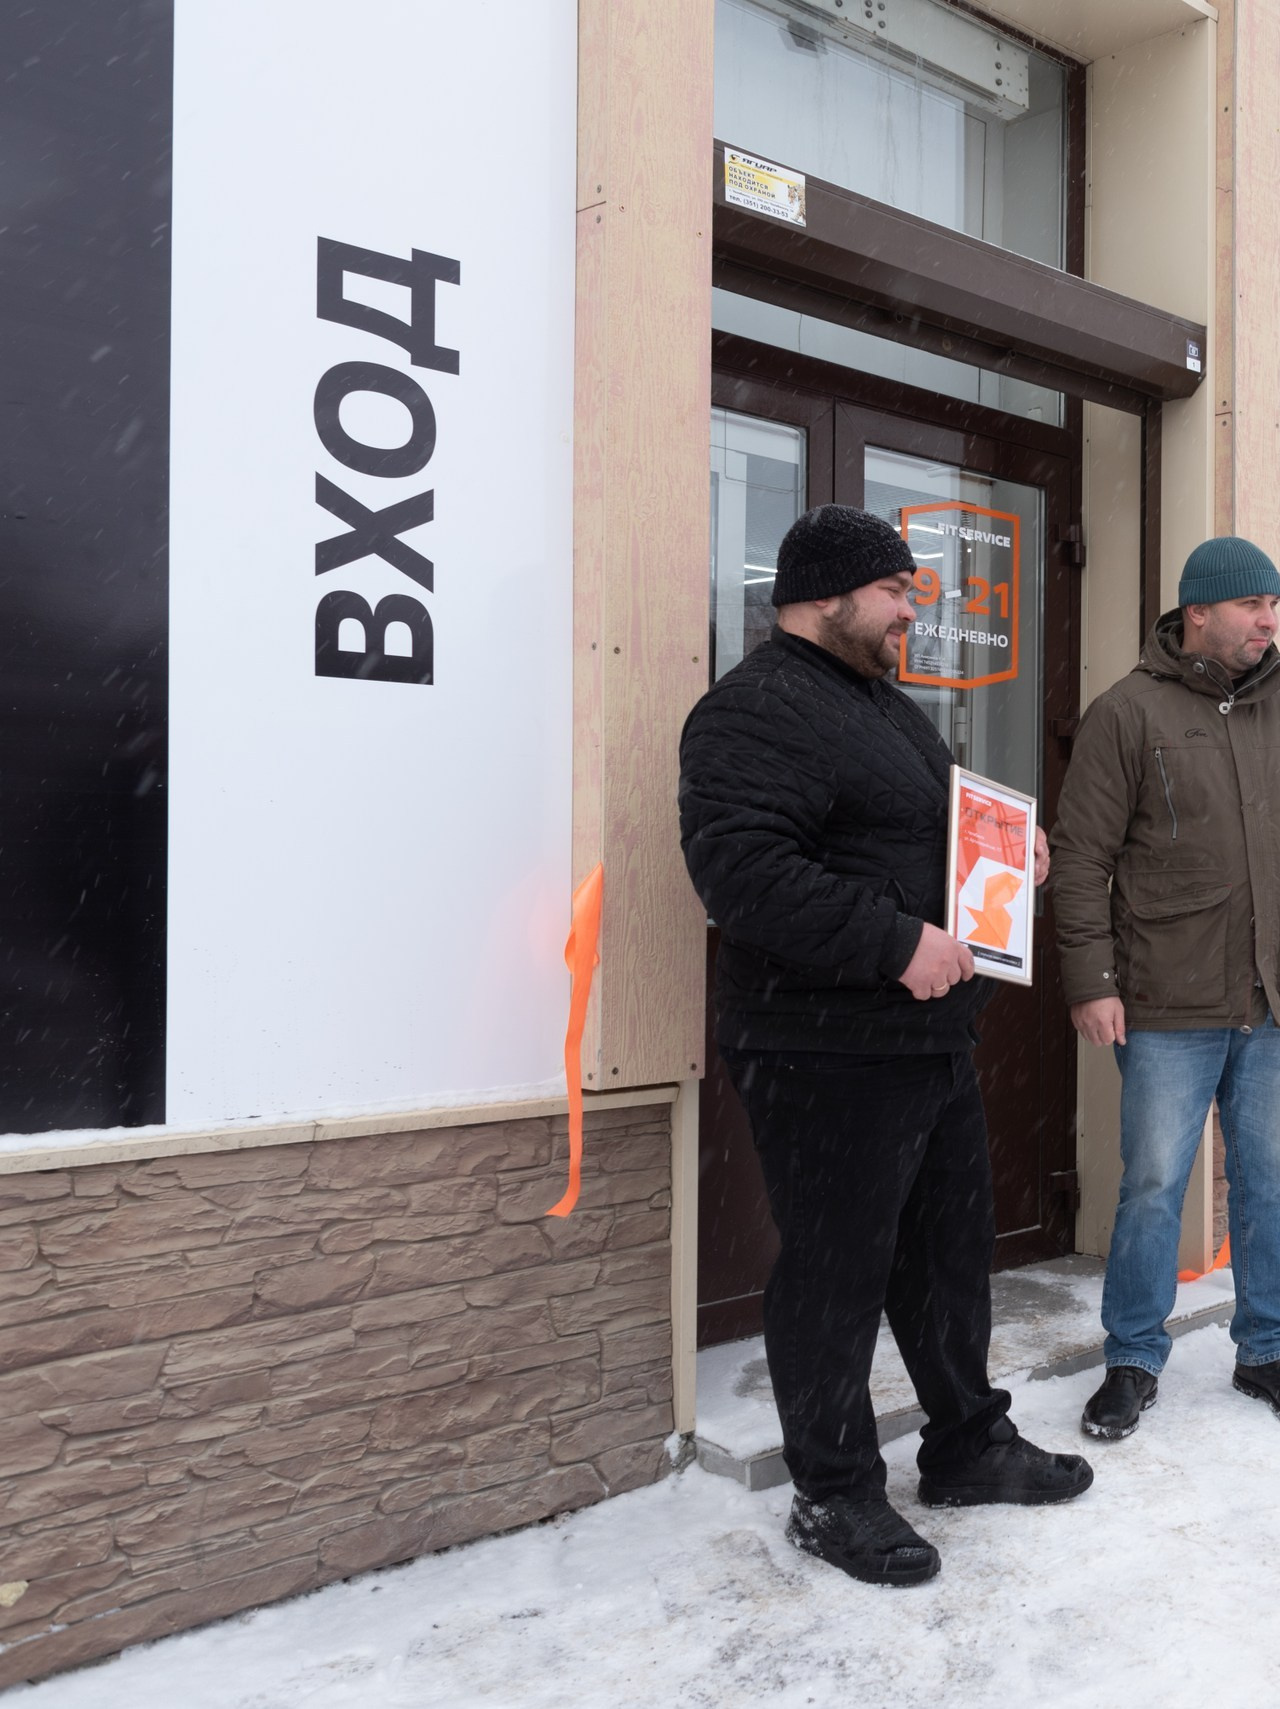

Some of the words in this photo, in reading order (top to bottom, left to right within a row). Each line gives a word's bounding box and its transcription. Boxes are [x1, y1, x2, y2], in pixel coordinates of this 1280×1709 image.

[728, 166, 755, 179] ОБЪЕКТ
[728, 173, 769, 190] НАХОДИТСЯ
[728, 180, 743, 189] ПОД
[744, 185, 776, 199] ОХРАНОЙ
[743, 199, 759, 209] (351)
[313, 236, 461, 686] ВХОД
[913, 567, 941, 606] 9
[966, 576, 1009, 618] 21
[914, 621, 1008, 648] ЕЖЕДНЕВНО
[965, 806, 1024, 838] ОТКРЫТИЕ
